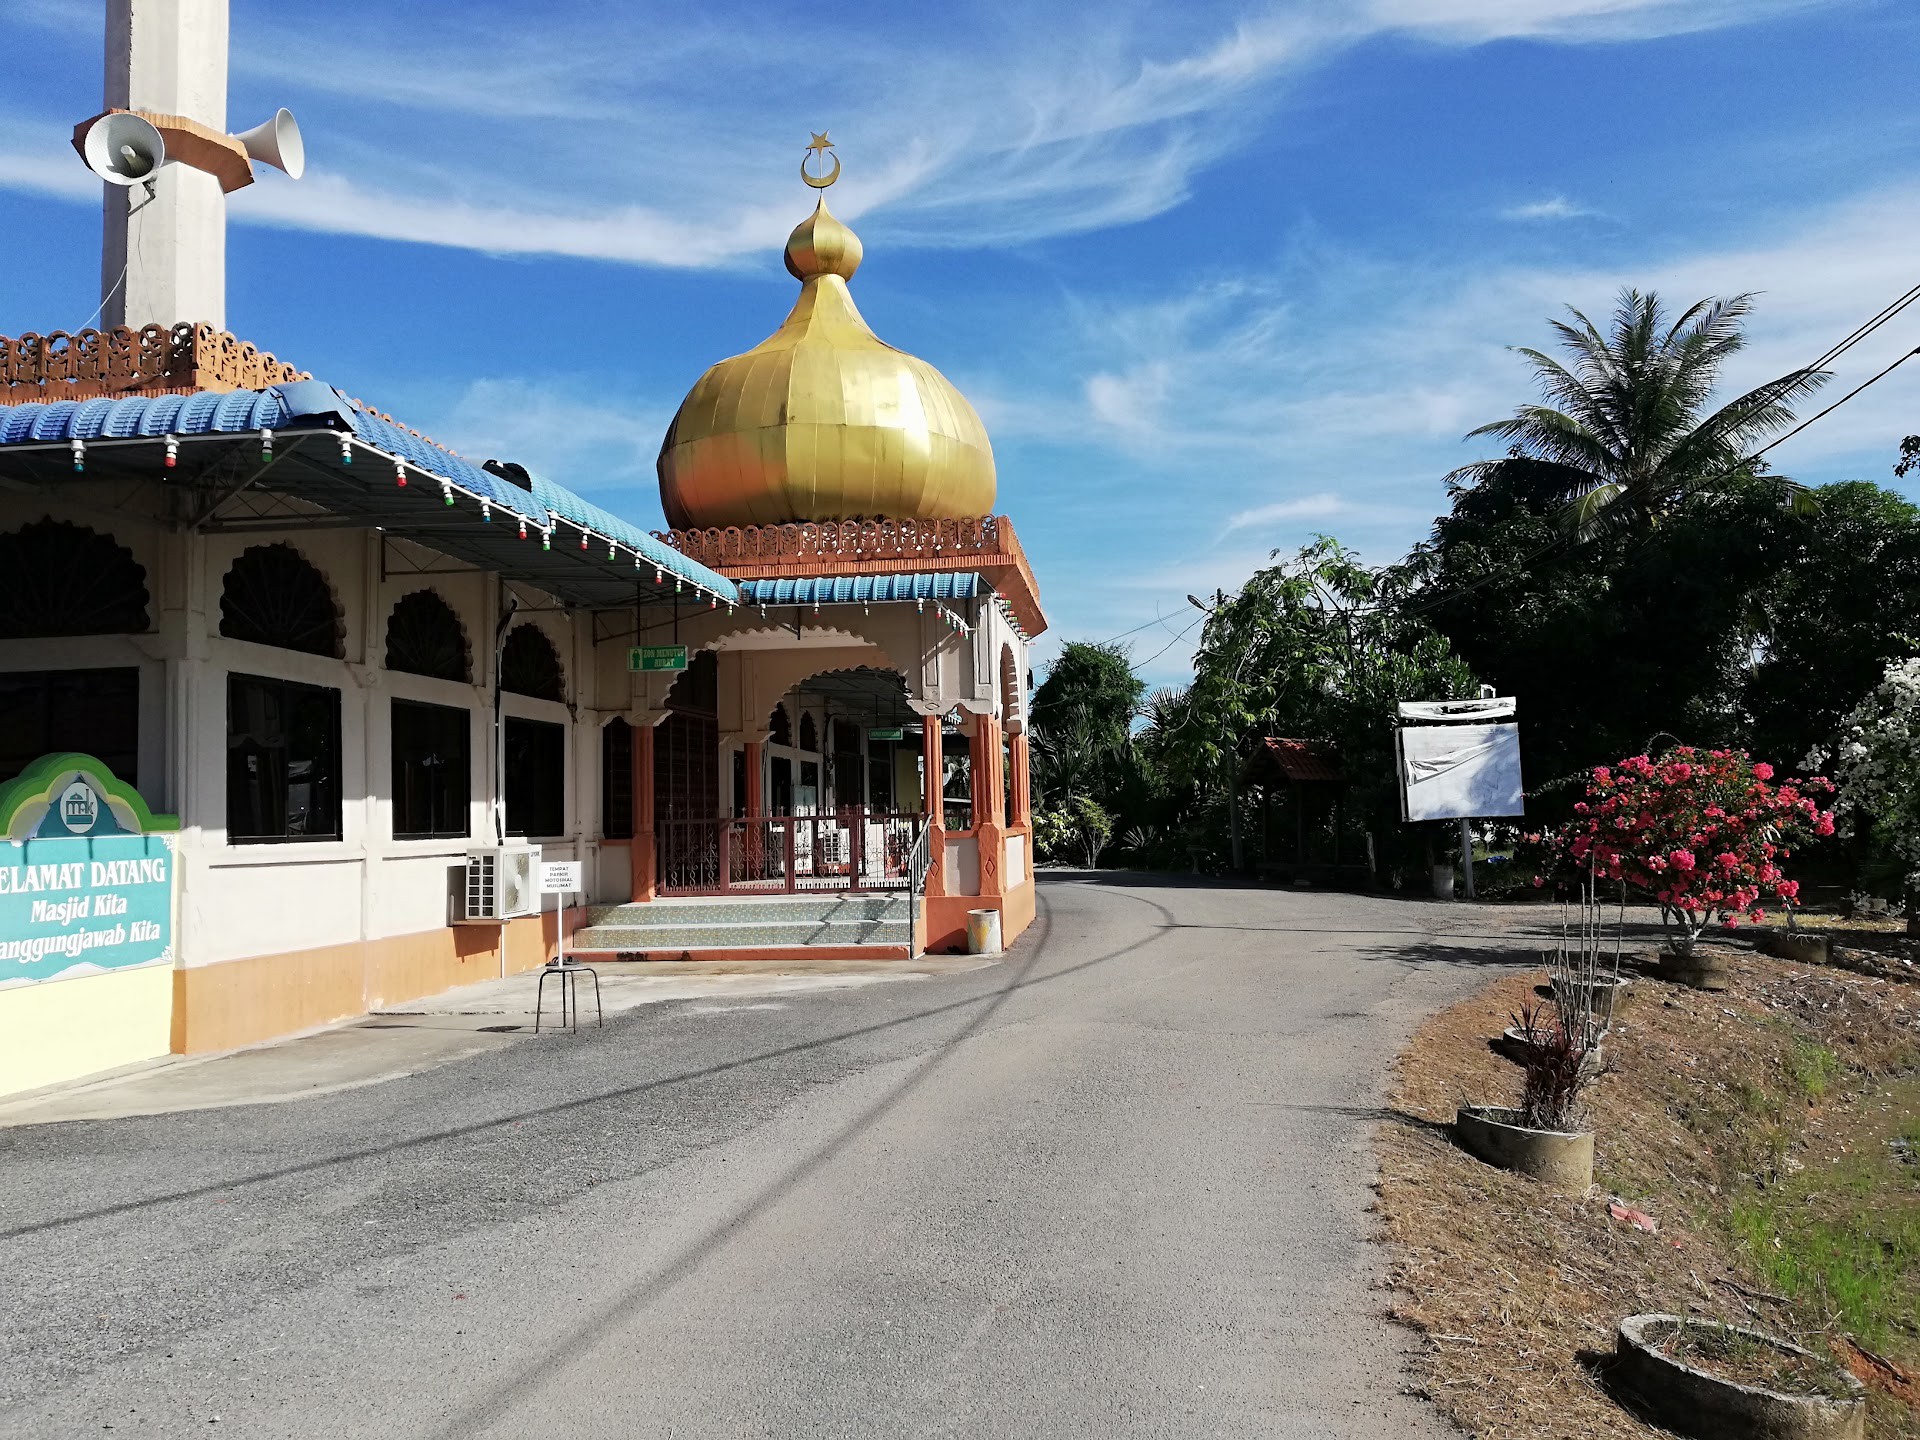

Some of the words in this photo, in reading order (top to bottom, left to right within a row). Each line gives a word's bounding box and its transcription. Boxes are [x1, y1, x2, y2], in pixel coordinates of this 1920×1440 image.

[654, 658, 675, 667] AURAT
[656, 648, 684, 657] MENUTUP
[0, 862, 85, 894] ELAMAT
[90, 858, 166, 887] DATANG
[30, 895, 90, 926] Masjid
[93, 893, 127, 916] Kita
[0, 922, 125, 964] anggungjawab
[129, 920, 161, 942] Kita
